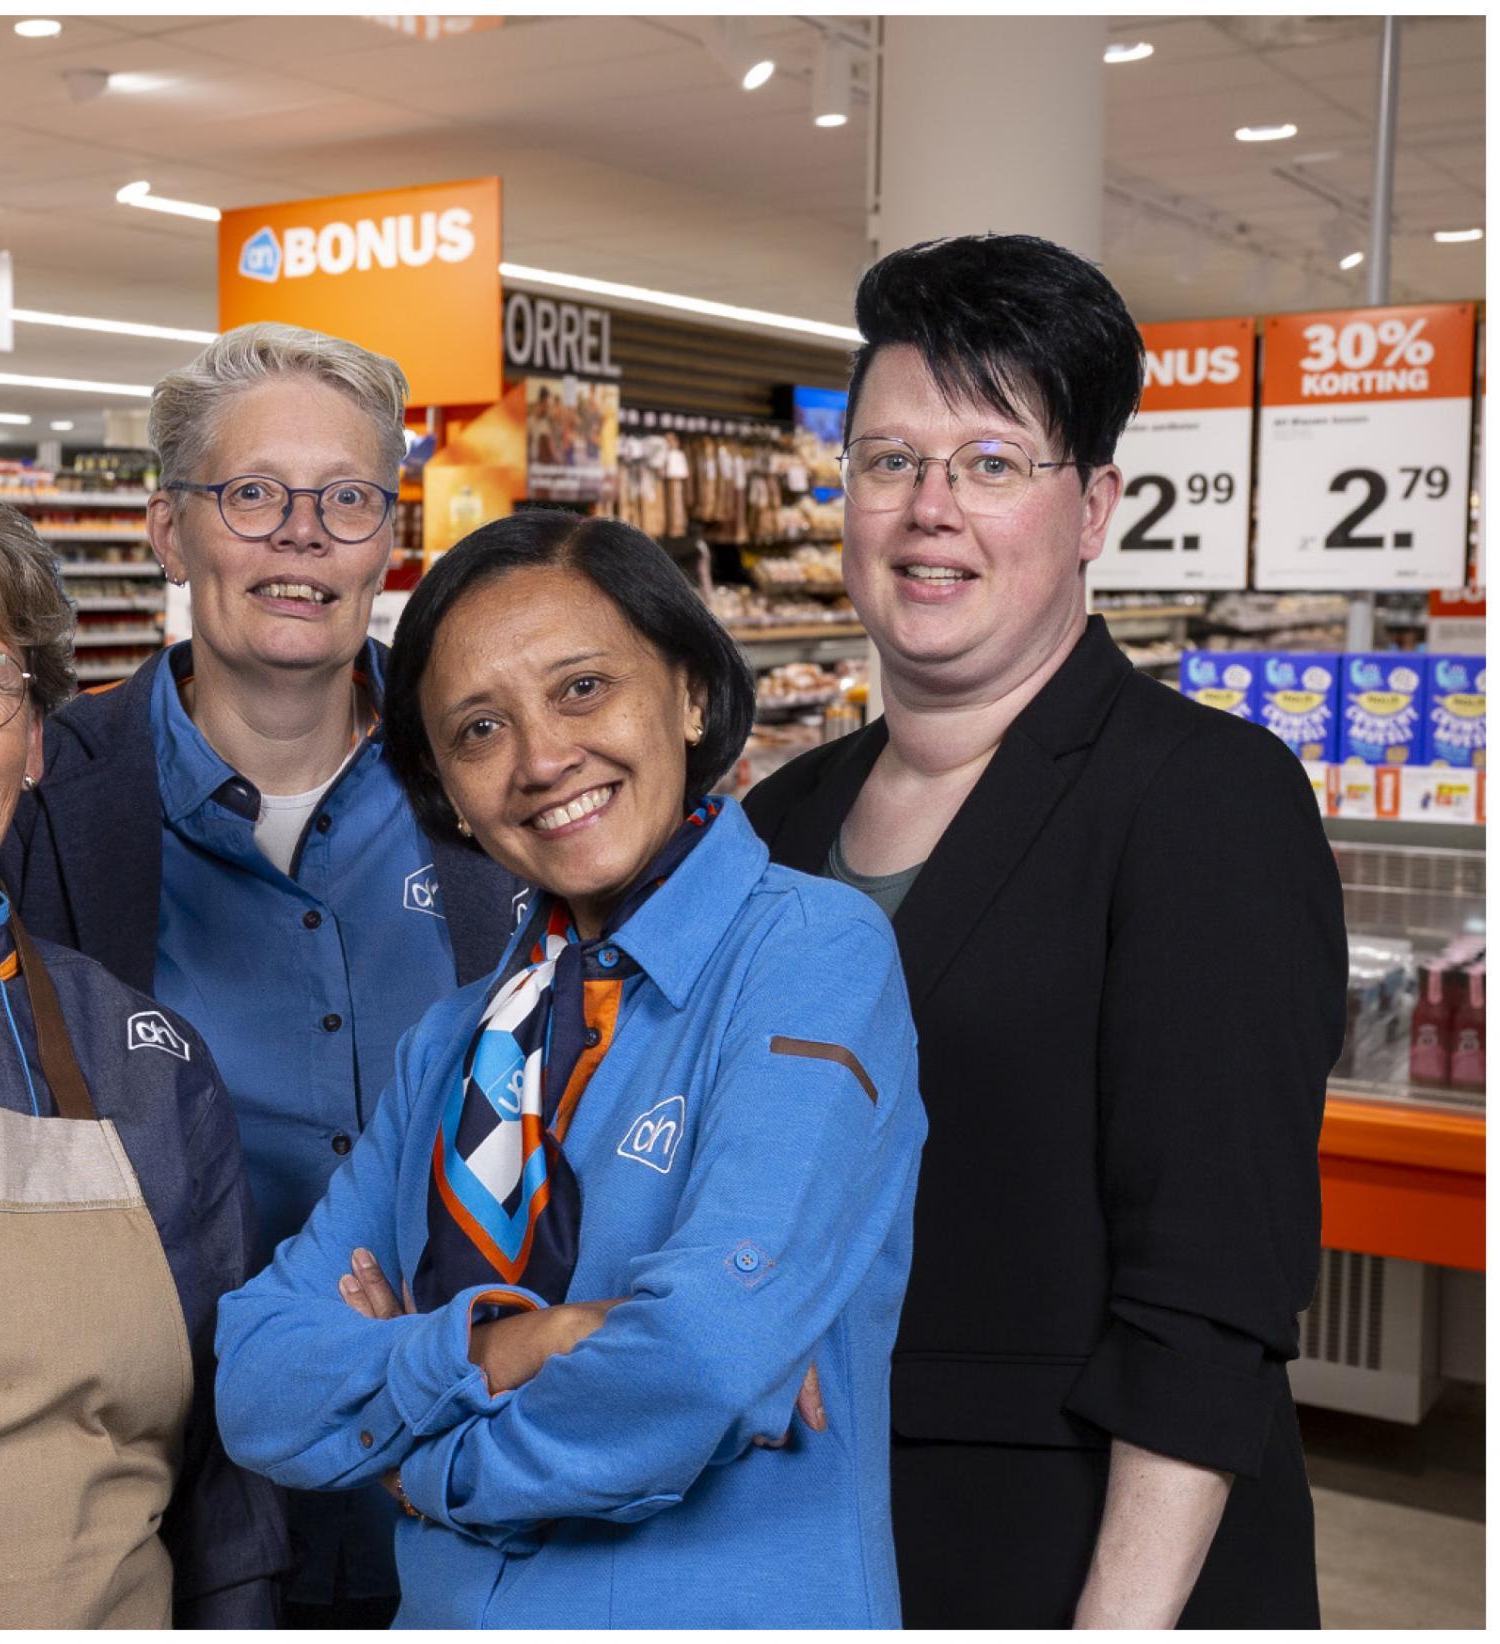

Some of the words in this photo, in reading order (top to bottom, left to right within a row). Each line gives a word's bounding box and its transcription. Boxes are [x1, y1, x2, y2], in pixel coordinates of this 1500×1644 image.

[283, 207, 475, 278] BONUS
[506, 293, 622, 377] ORREL
[1299, 318, 1434, 370] 30%
[1143, 345, 1241, 388] NUS
[1301, 368, 1429, 397] KORTING
